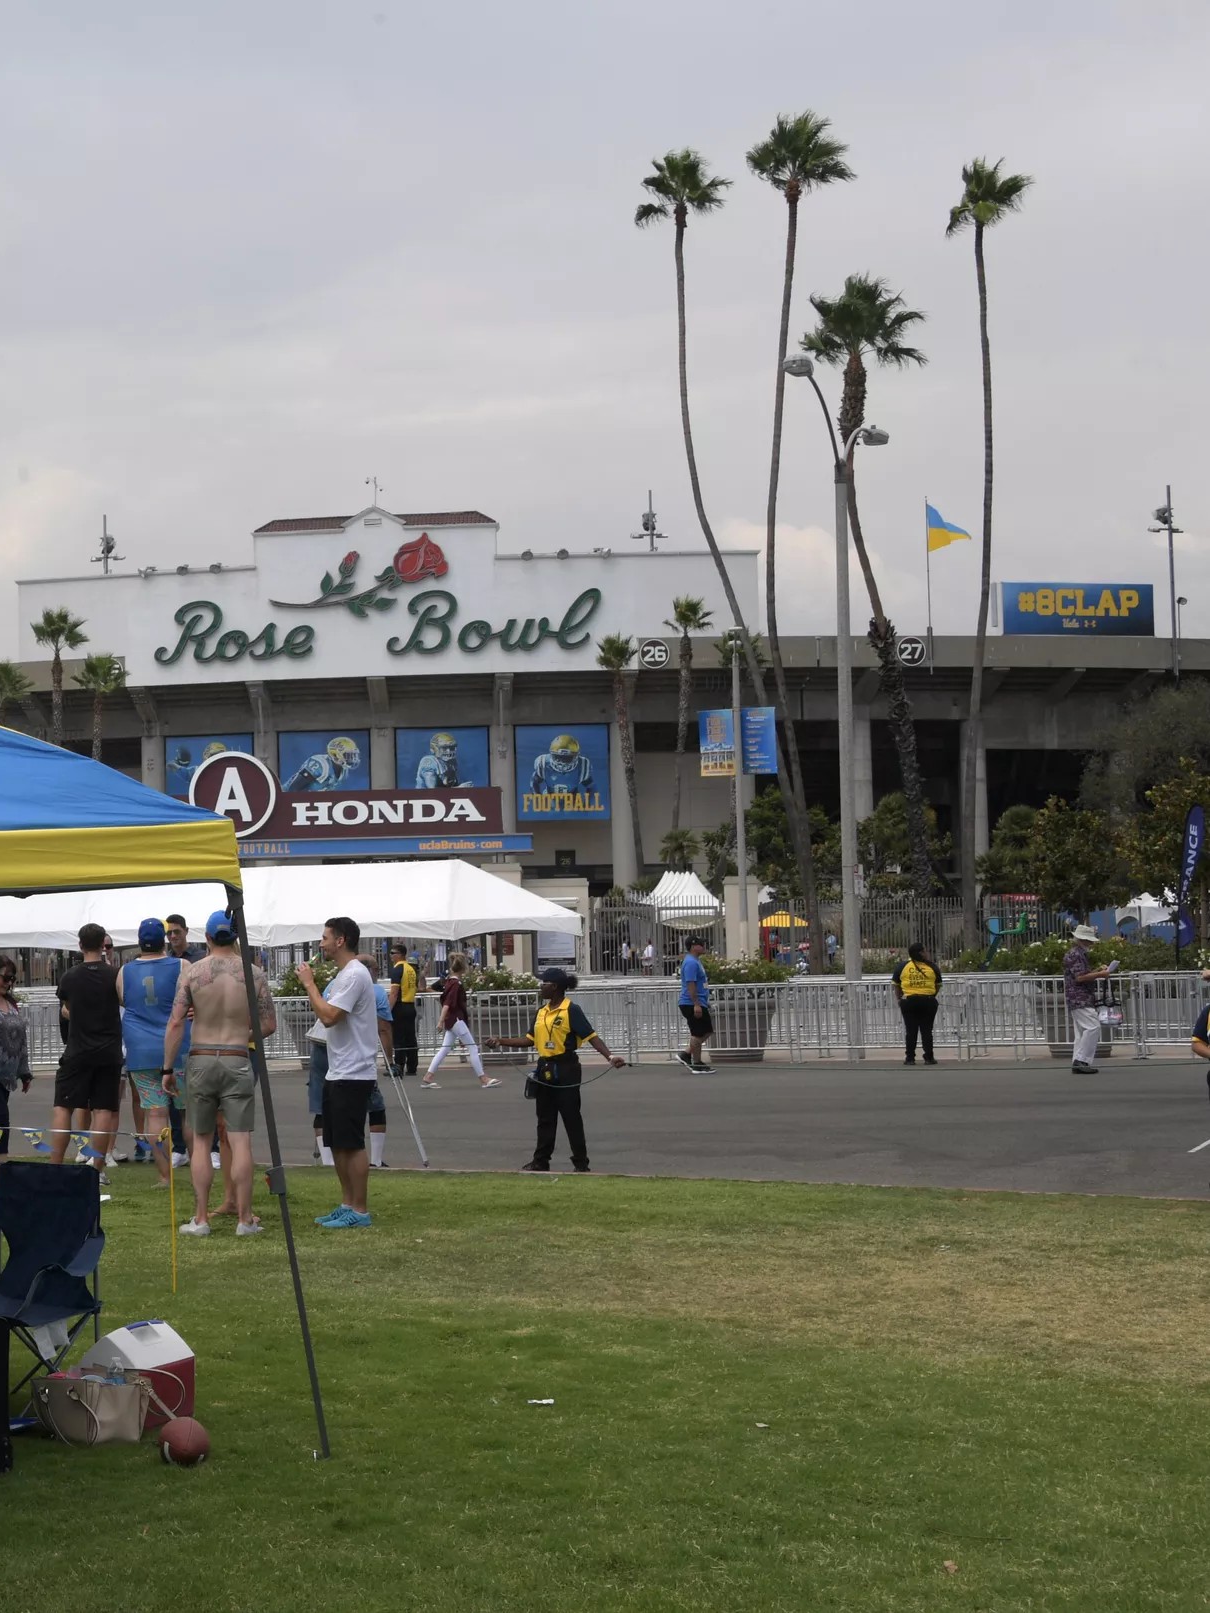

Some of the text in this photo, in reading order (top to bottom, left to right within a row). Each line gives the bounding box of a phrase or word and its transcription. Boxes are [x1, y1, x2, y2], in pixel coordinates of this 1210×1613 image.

[1018, 588, 1140, 617] #8CLAP
[154, 588, 602, 665] Rose Bowl
[643, 646, 666, 662] 26
[900, 643, 922, 660] 27
[215, 767, 252, 822] A
[523, 792, 605, 812] FOOTBALL
[292, 798, 487, 826] HONDA
[237, 843, 290, 855] FOOTBALL
[142, 976, 159, 1006] 1
